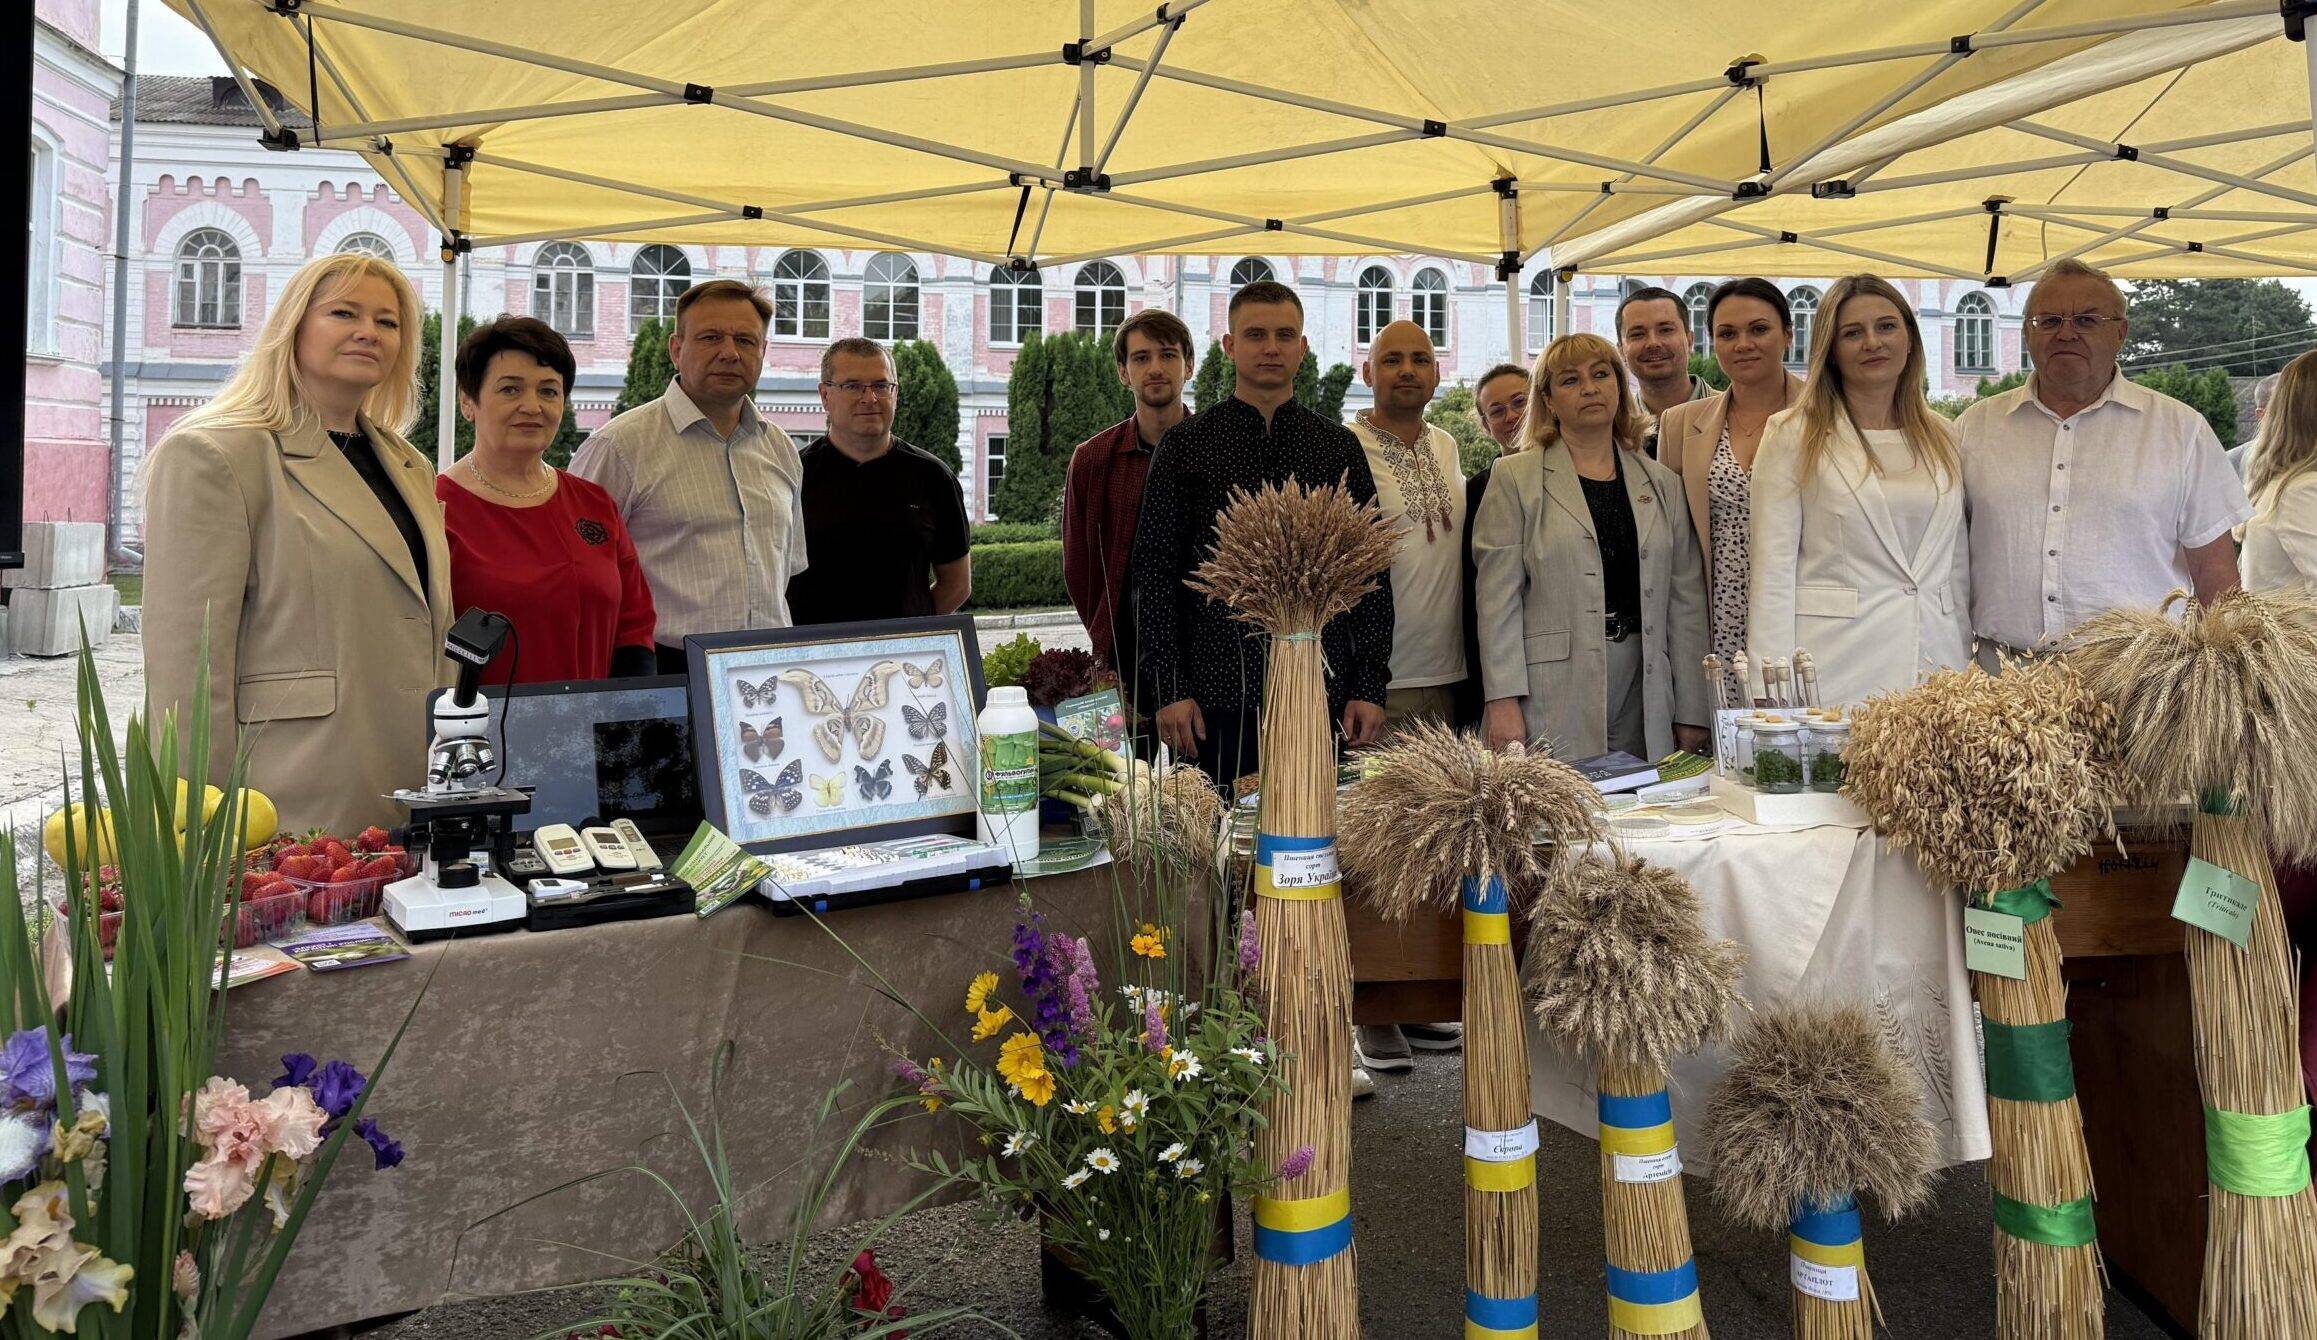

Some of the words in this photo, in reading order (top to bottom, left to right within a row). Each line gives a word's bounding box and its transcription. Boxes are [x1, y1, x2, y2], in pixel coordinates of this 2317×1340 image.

[1278, 873, 1303, 887] Зоря
[1966, 925, 1985, 936] Овес
[1986, 931, 2022, 944] посівний
[1973, 937, 1994, 947] (Avena
